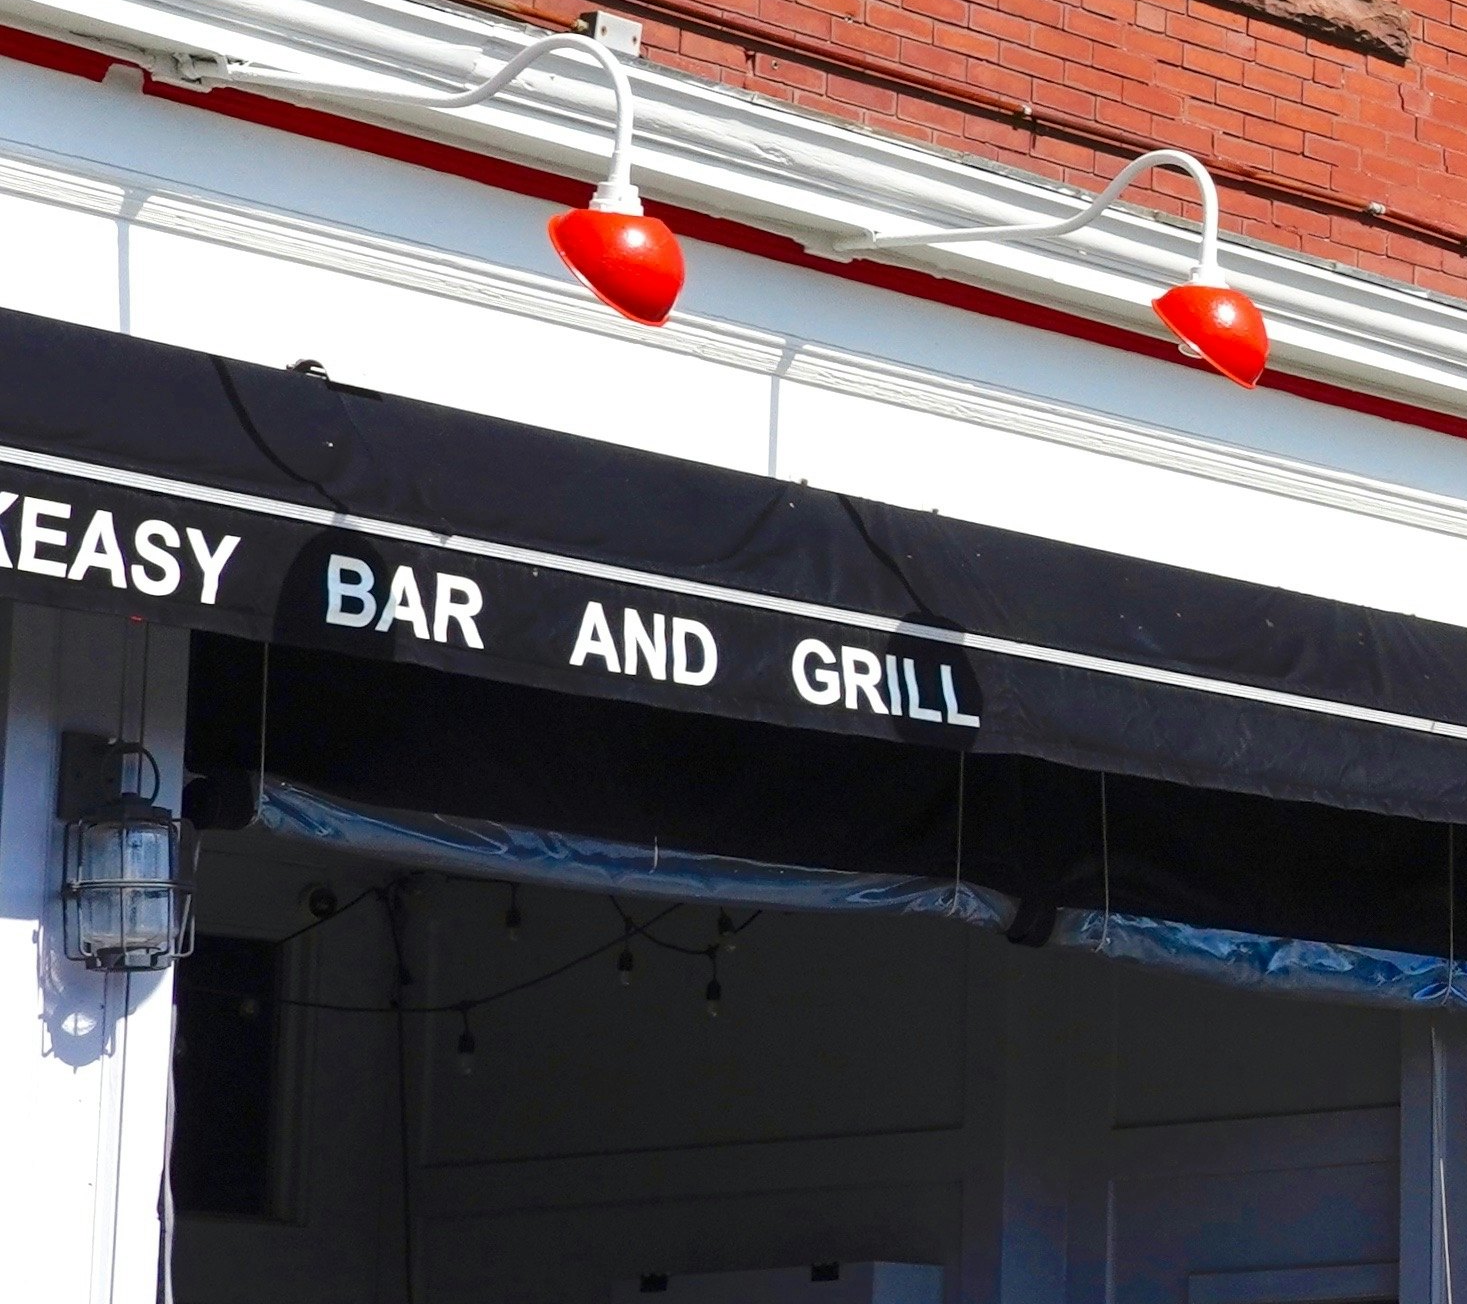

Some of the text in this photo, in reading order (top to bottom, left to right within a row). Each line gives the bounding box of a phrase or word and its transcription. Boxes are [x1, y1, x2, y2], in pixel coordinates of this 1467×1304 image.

[325, 553, 485, 650] BAR
[570, 600, 718, 688] AND
[791, 637, 982, 729] GRILL
